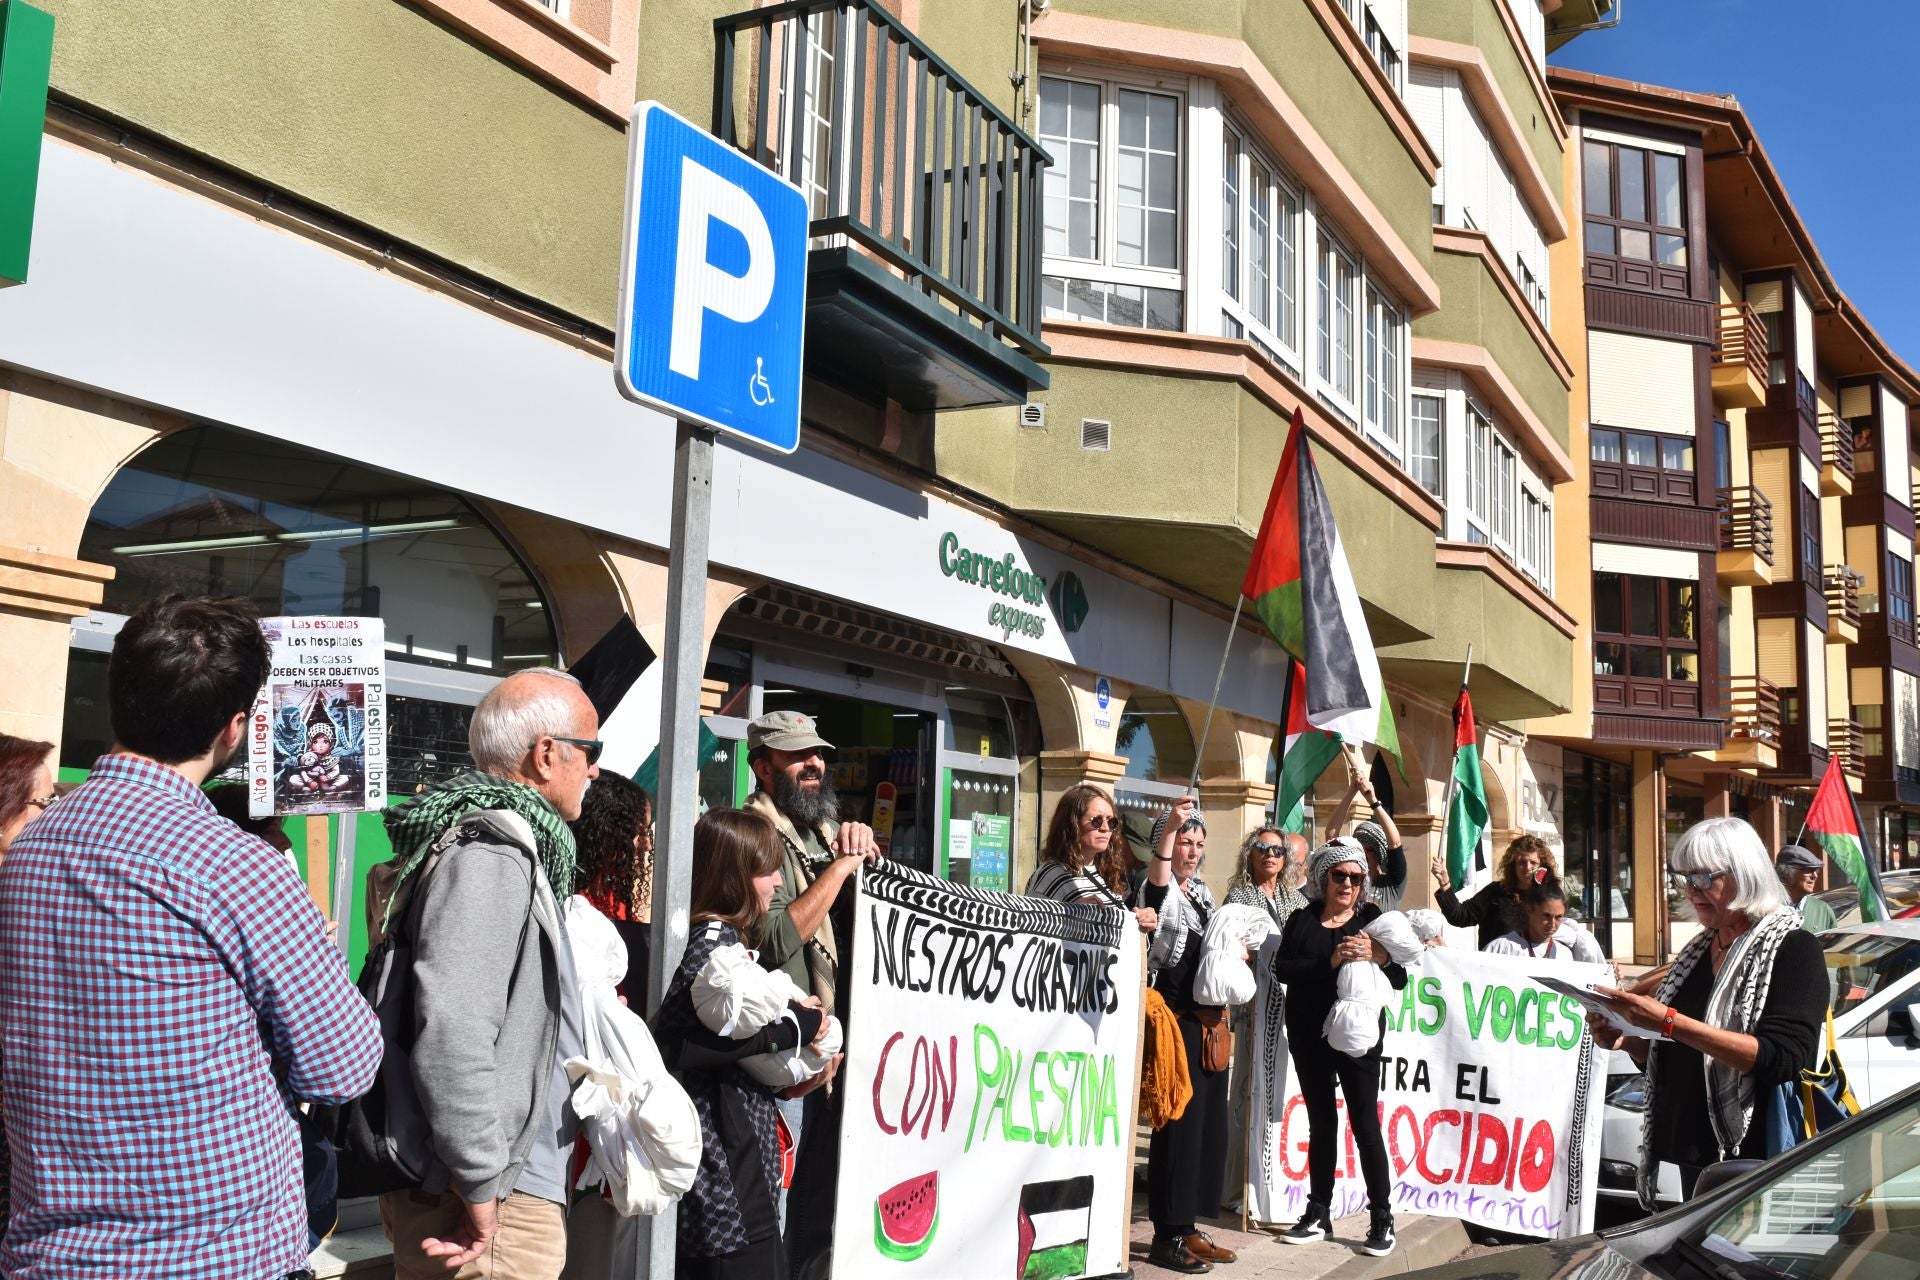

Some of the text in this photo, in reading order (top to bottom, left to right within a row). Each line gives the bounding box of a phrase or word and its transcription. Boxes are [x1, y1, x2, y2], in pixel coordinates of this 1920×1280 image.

[669, 155, 775, 381] P
[938, 531, 1046, 607] Carrefour
[288, 636, 363, 649] Los hospitales
[291, 618, 311, 629] Las
[314, 618, 359, 629] escuelas
[988, 602, 1046, 643] express
[273, 666, 380, 677] DEBEN SER OBJETIVOS
[300, 654, 353, 664] Las casas
[367, 683, 384, 799] Palestina libre
[871, 904, 1119, 1015] NUESTROS CORAZONES
[1462, 981, 1583, 1051] VOCES
[872, 1022, 1120, 1154] CON PALESTINA
[1380, 1055, 1501, 1104] TRA EL
